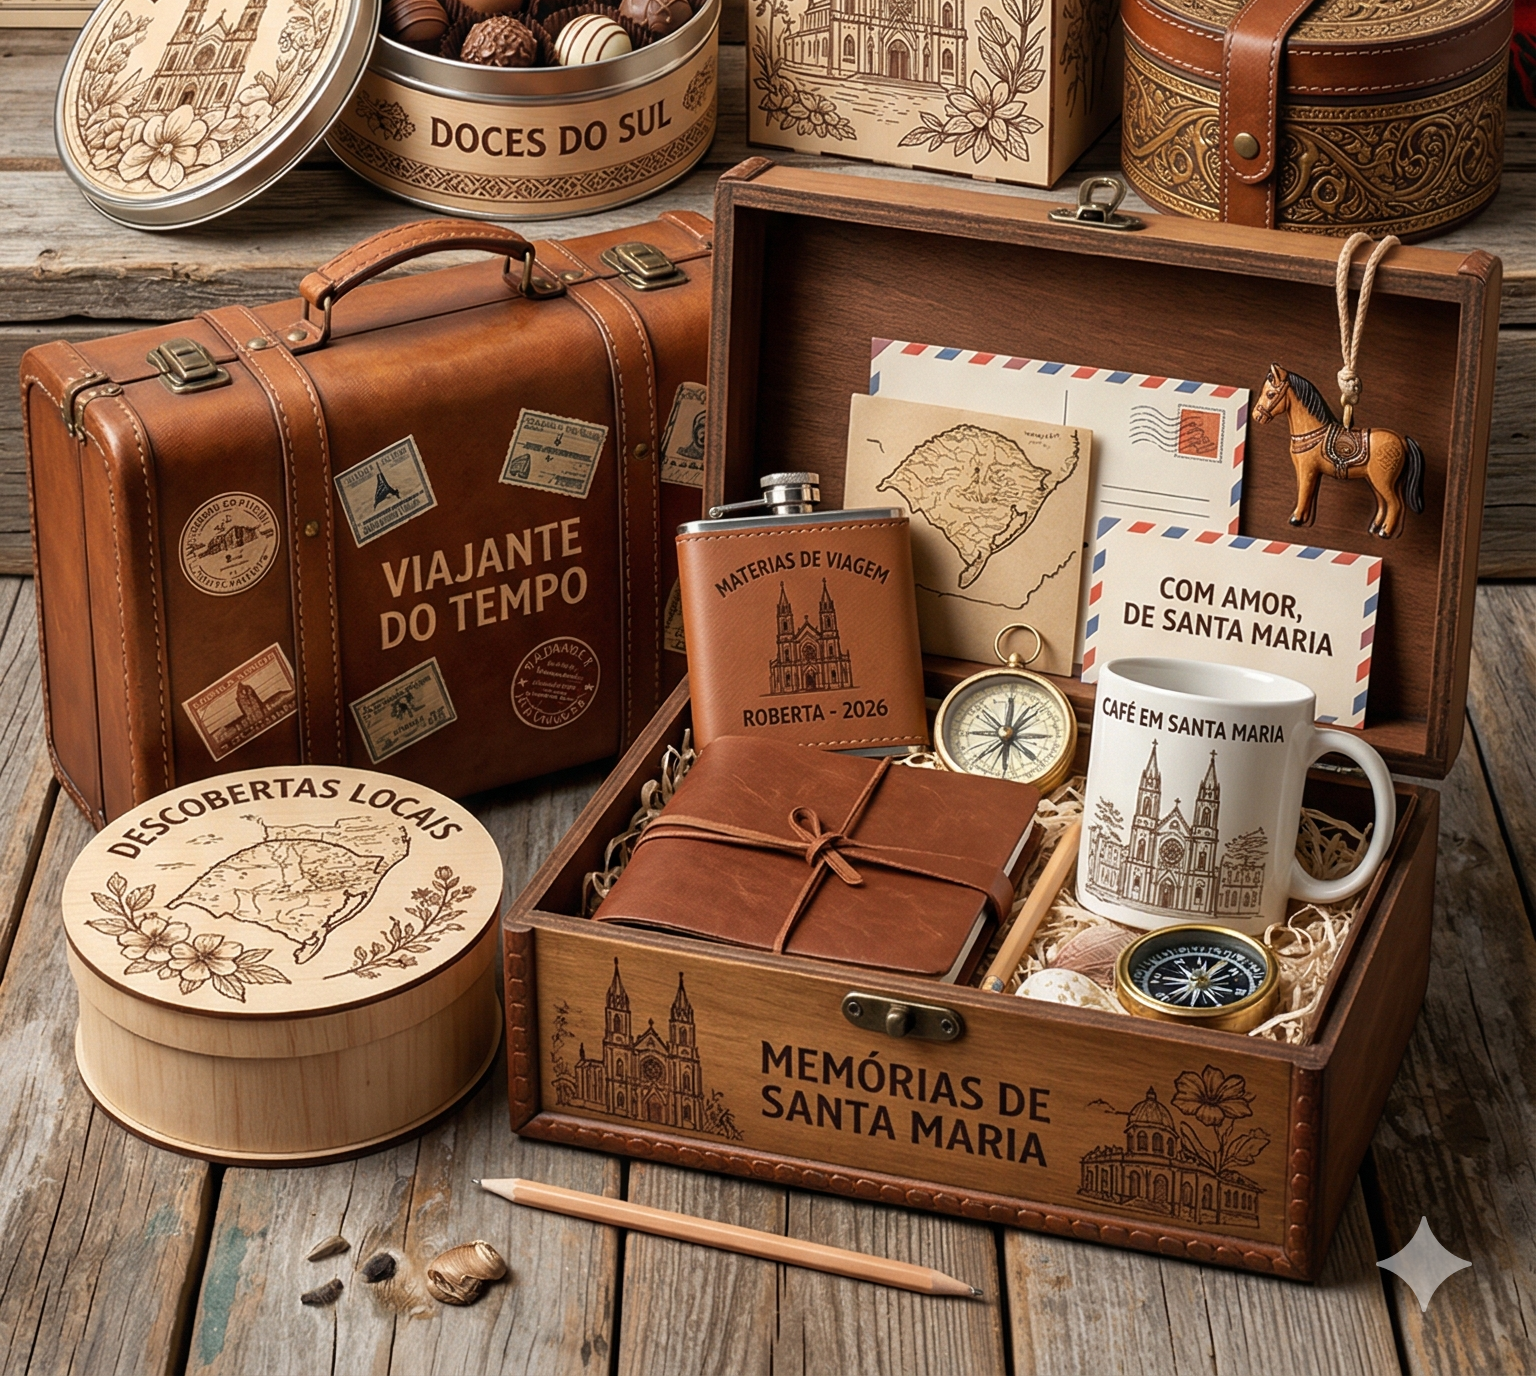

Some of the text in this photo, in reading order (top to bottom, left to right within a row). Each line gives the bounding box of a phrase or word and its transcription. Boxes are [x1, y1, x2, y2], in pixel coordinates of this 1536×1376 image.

[430, 99, 672, 157] DOCES DO SUL
[381, 516, 583, 598] VIAJANTE
[714, 550, 890, 599] MATERIAS DE VIAGEM
[380, 566, 588, 650] DO TEMPO
[1160, 576, 1302, 624] COM AMOR,
[1123, 602, 1333, 657] DE SANTA MARIA
[743, 704, 825, 727] ROBERTA
[842, 699, 888, 719] 2026
[1102, 697, 1285, 743] CAFÉ EM SANTA MARIA
[107, 777, 463, 859] DESCOBERTAS LOCAIS
[761, 1040, 1051, 1124] MEMÓRIAS DE
[761, 1084, 1047, 1168] SANTA MARIA
